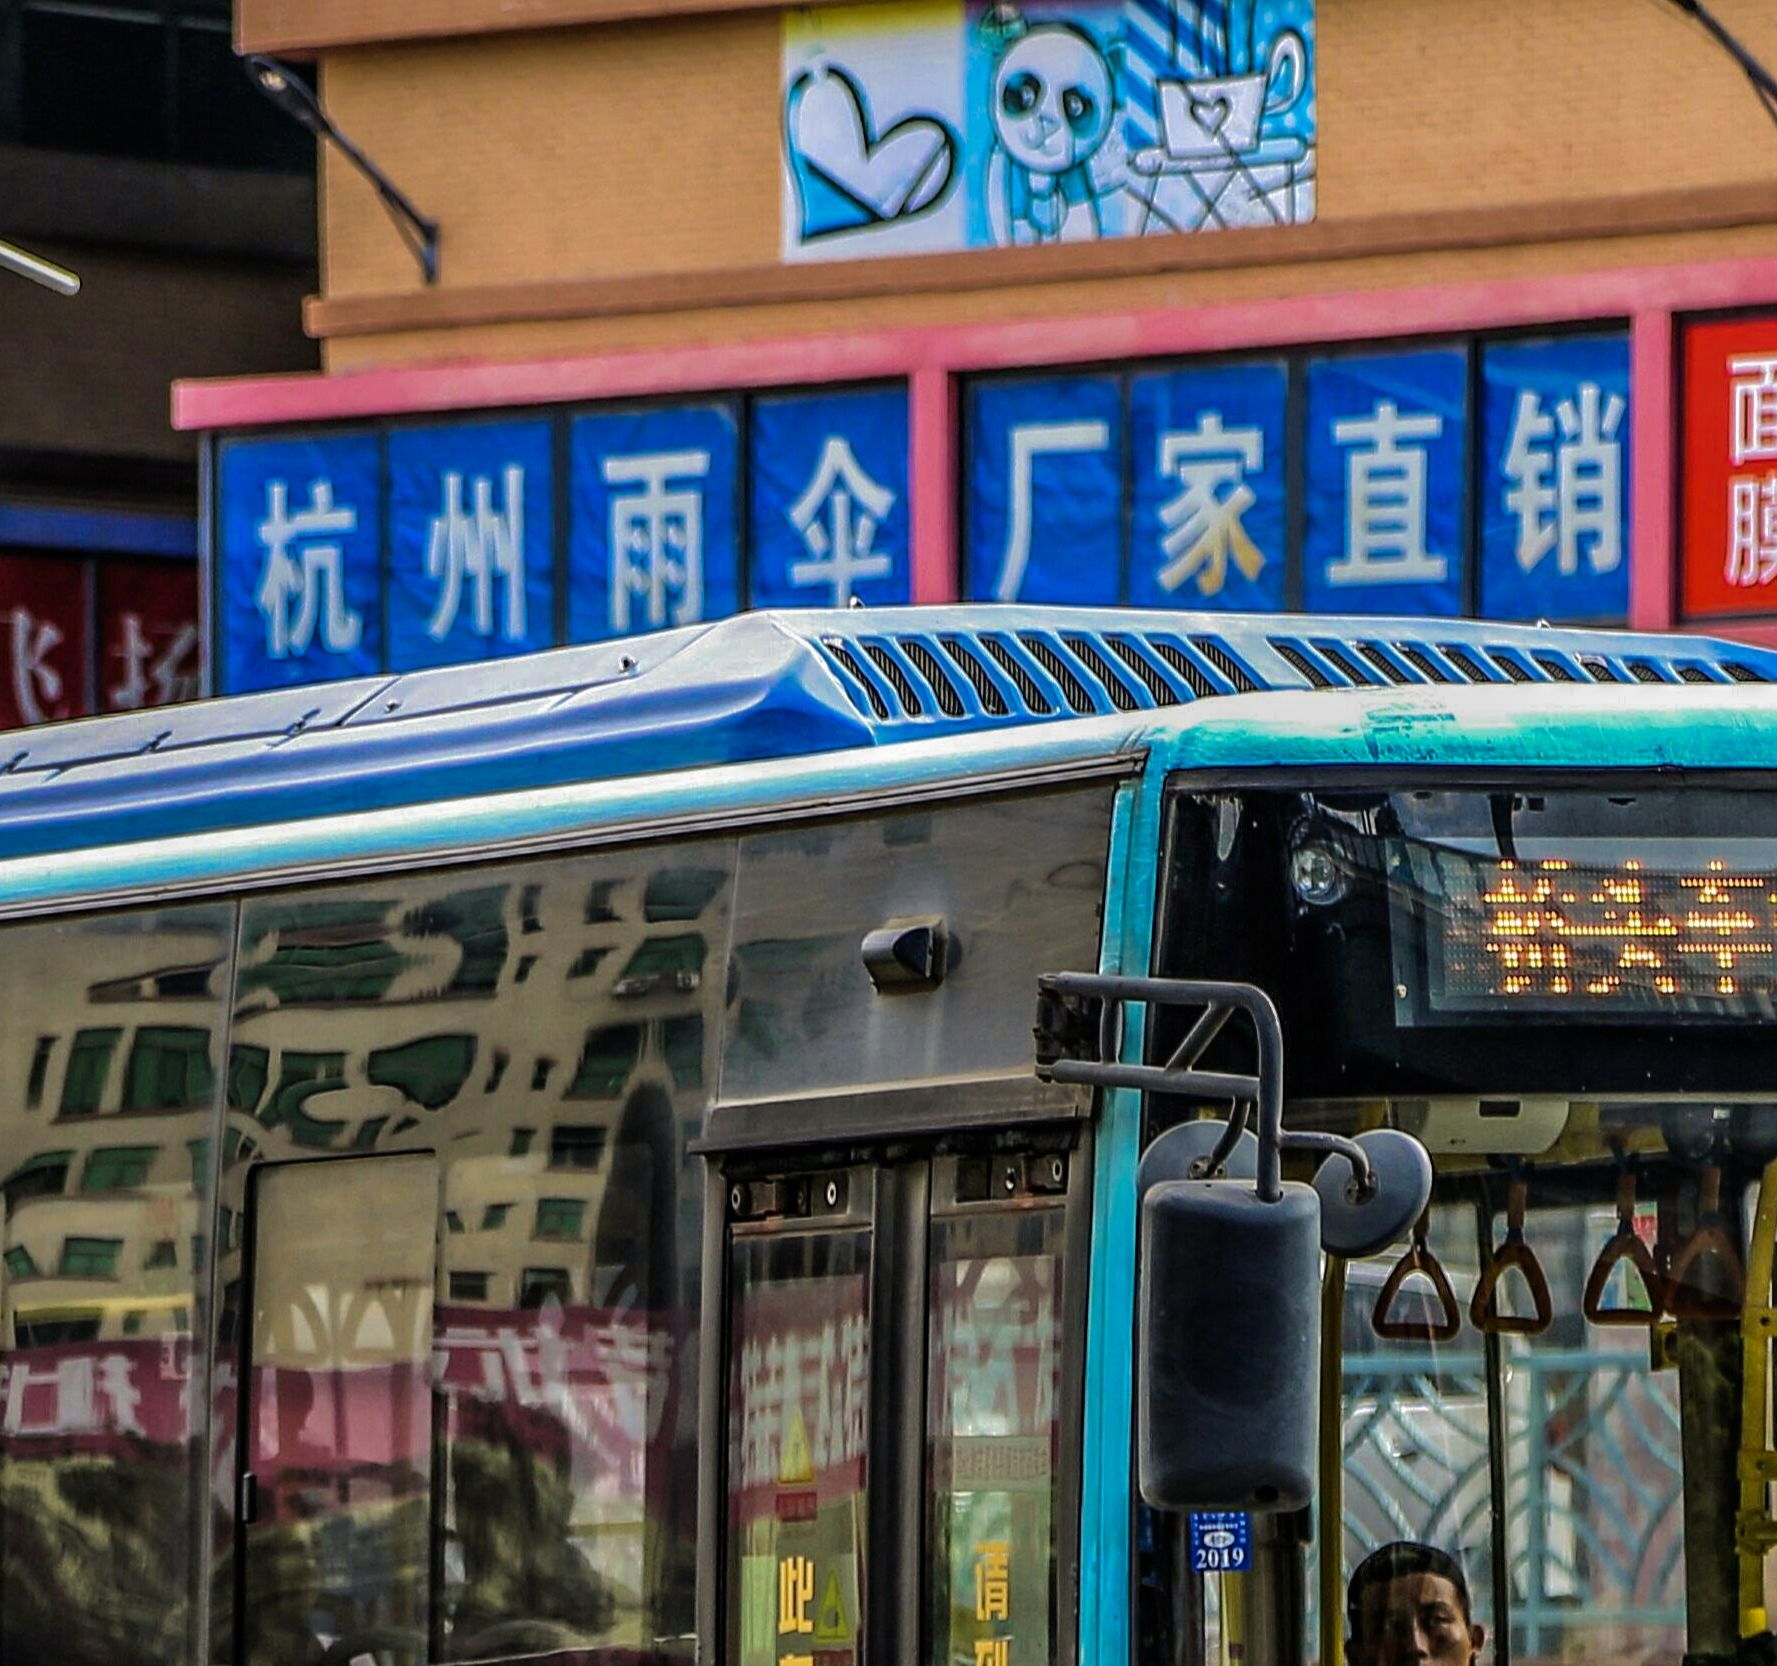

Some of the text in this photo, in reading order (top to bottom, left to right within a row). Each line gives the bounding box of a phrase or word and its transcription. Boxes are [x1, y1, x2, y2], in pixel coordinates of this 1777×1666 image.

[258, 381, 1625, 660] 杭州雨伞 厂家直销
[1196, 1548, 1245, 1569] 2019
